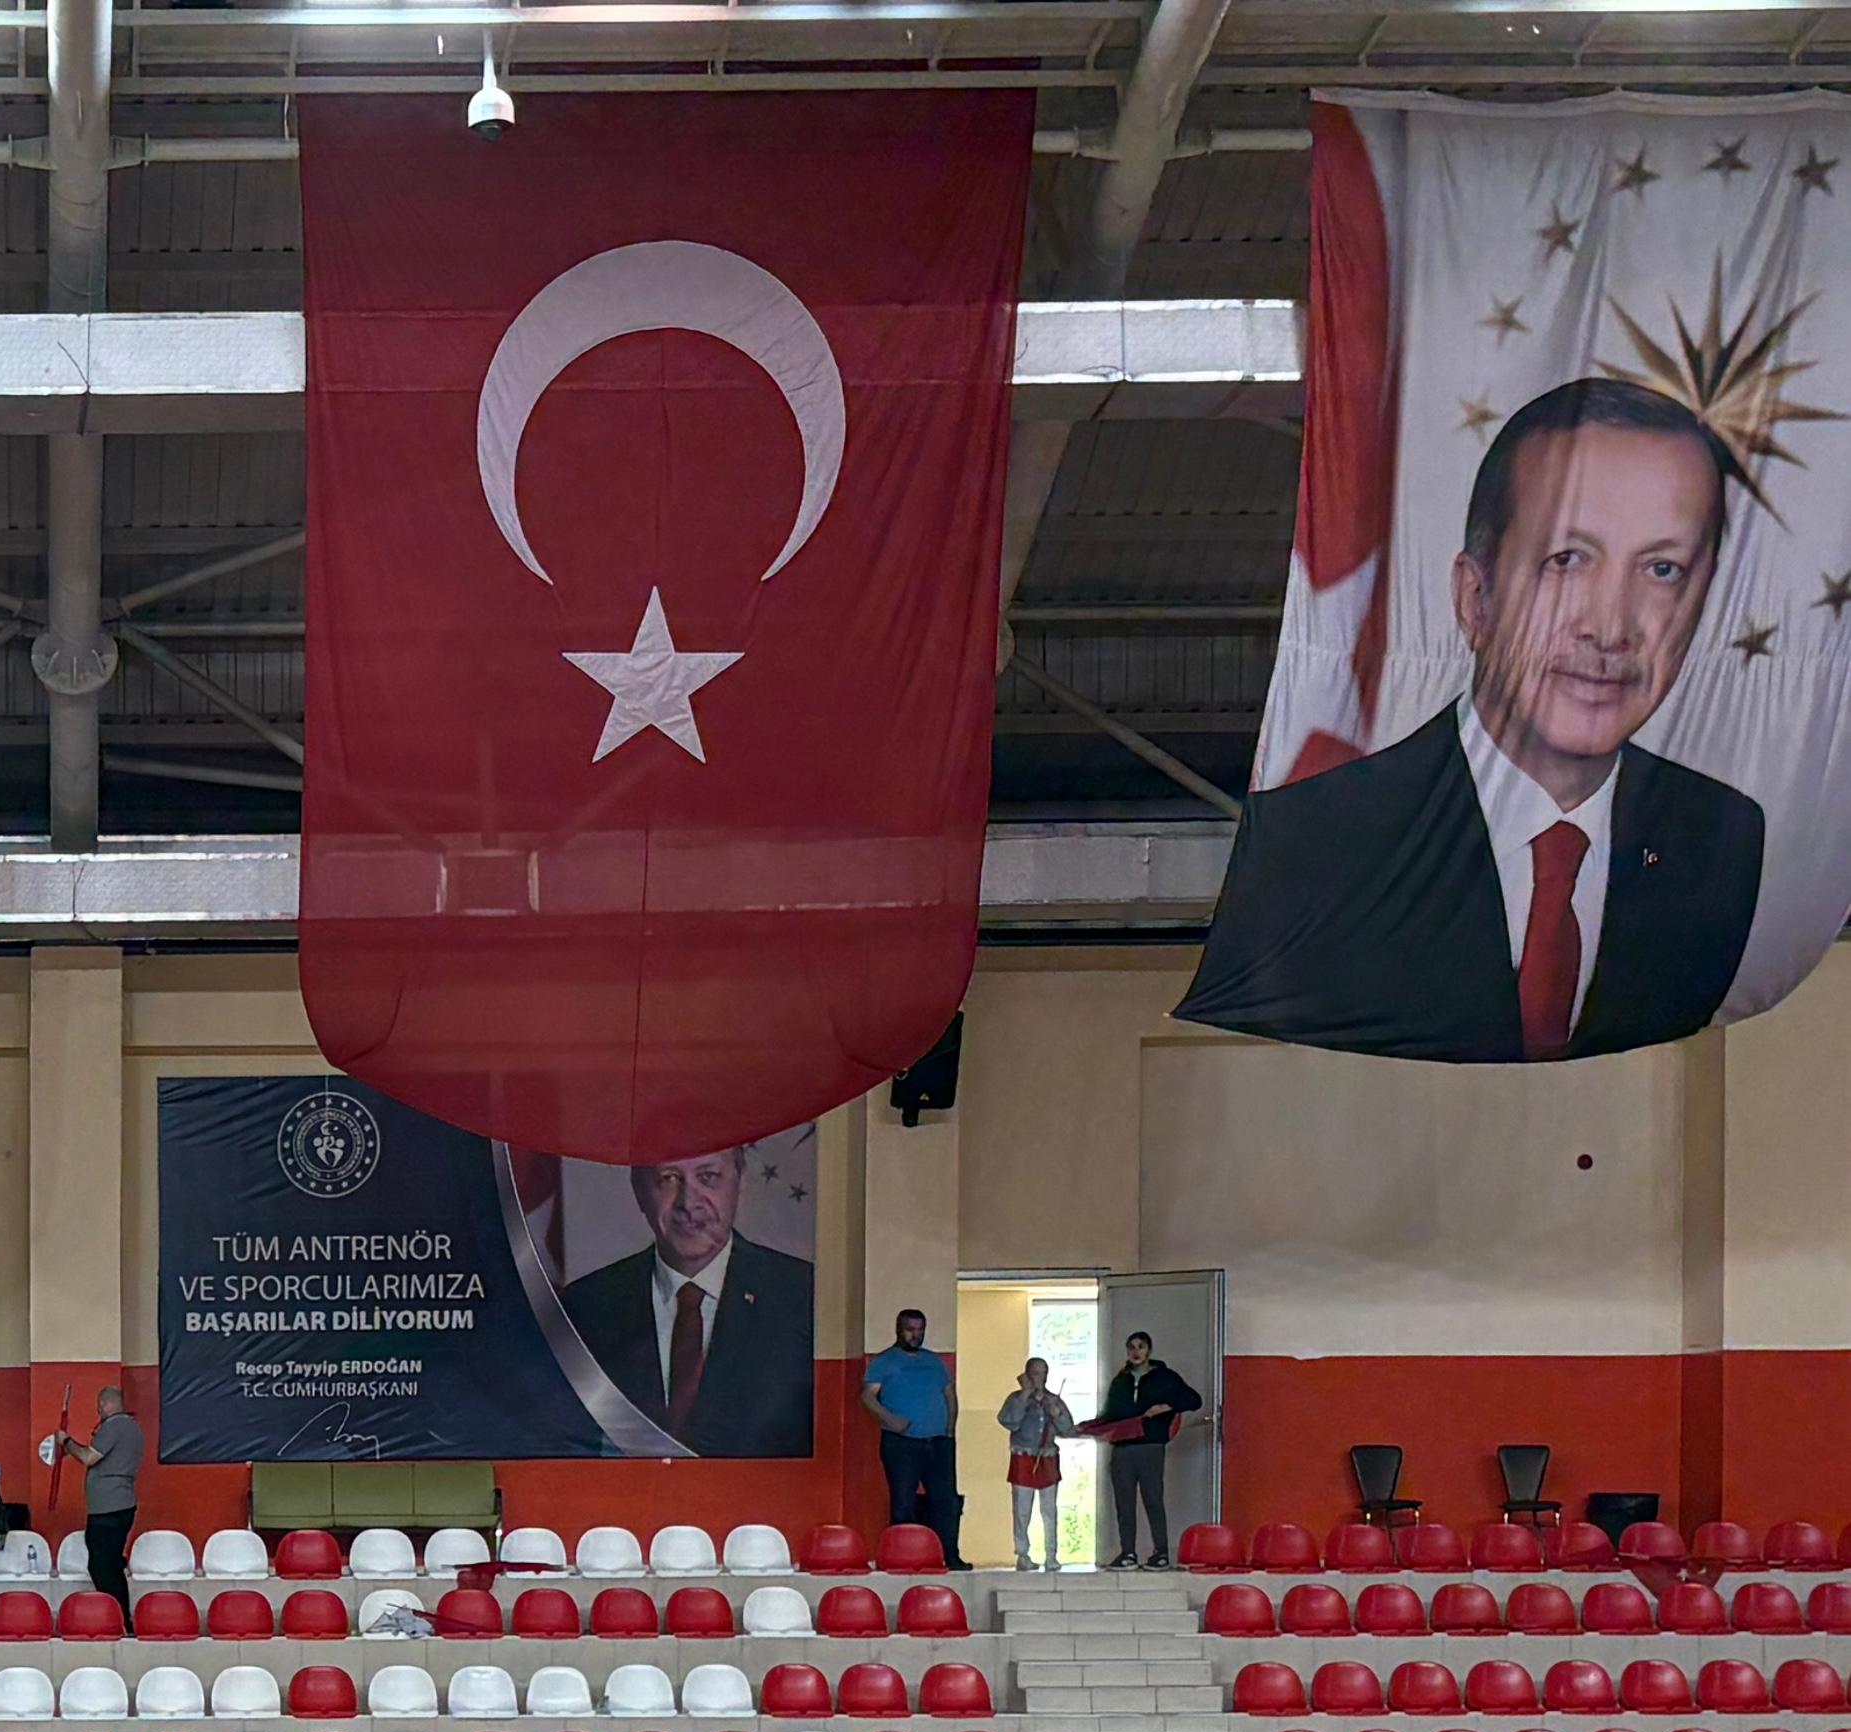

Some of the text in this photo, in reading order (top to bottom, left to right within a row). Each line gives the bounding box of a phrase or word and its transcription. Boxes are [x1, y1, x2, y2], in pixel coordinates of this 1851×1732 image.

[212, 1230, 451, 1262] TÜM ANTRENÖR
[179, 1273, 485, 1301] VE SPORCULARIMIZA
[185, 1305, 474, 1337] BAŞARILAR DİLİYORUM
[235, 1358, 422, 1378] Recep Tayyip ERDOĞAN
[240, 1381, 418, 1400] T.C. CUMHURBAŞKANI
